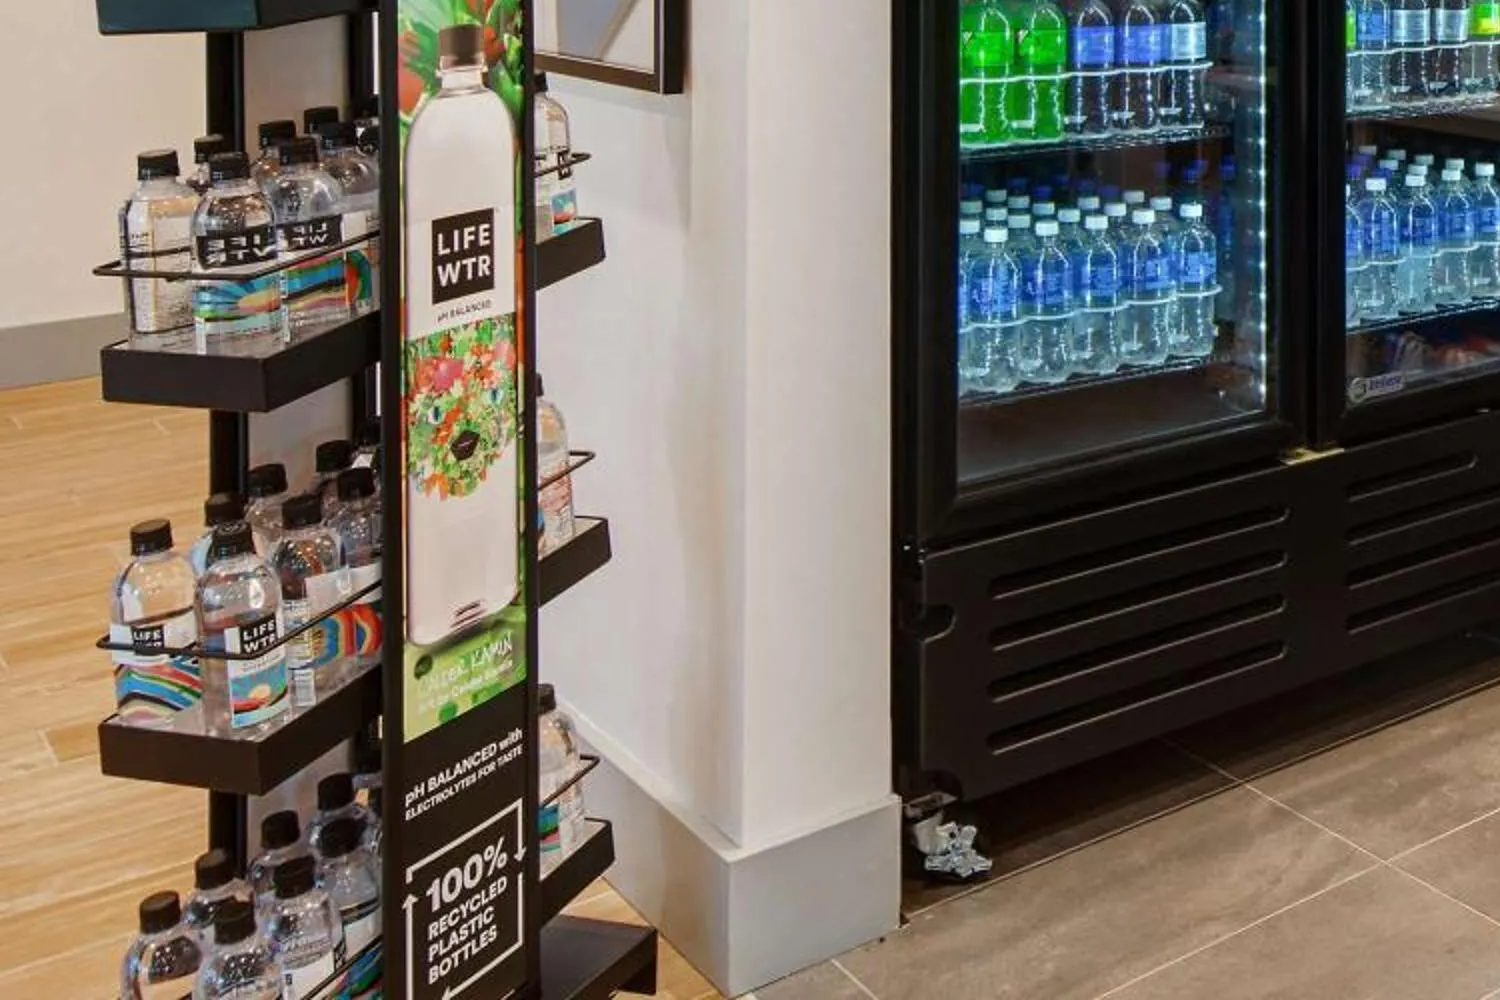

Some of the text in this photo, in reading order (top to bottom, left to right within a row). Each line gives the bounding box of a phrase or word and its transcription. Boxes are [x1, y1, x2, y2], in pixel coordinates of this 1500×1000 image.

[437, 223, 491, 257] LIFE
[437, 255, 491, 288] WTR
[133, 631, 162, 642] LIFE
[243, 618, 275, 641] LIFE
[405, 727, 523, 809] pH BALANCED with
[405, 744, 523, 821] ELECTROLYTES FOR TASTE
[426, 836, 507, 913] 100%
[427, 876, 508, 942] RECYCLED
[427, 906, 496, 964] PLASTIC
[428, 925, 498, 986] BOTTLES
